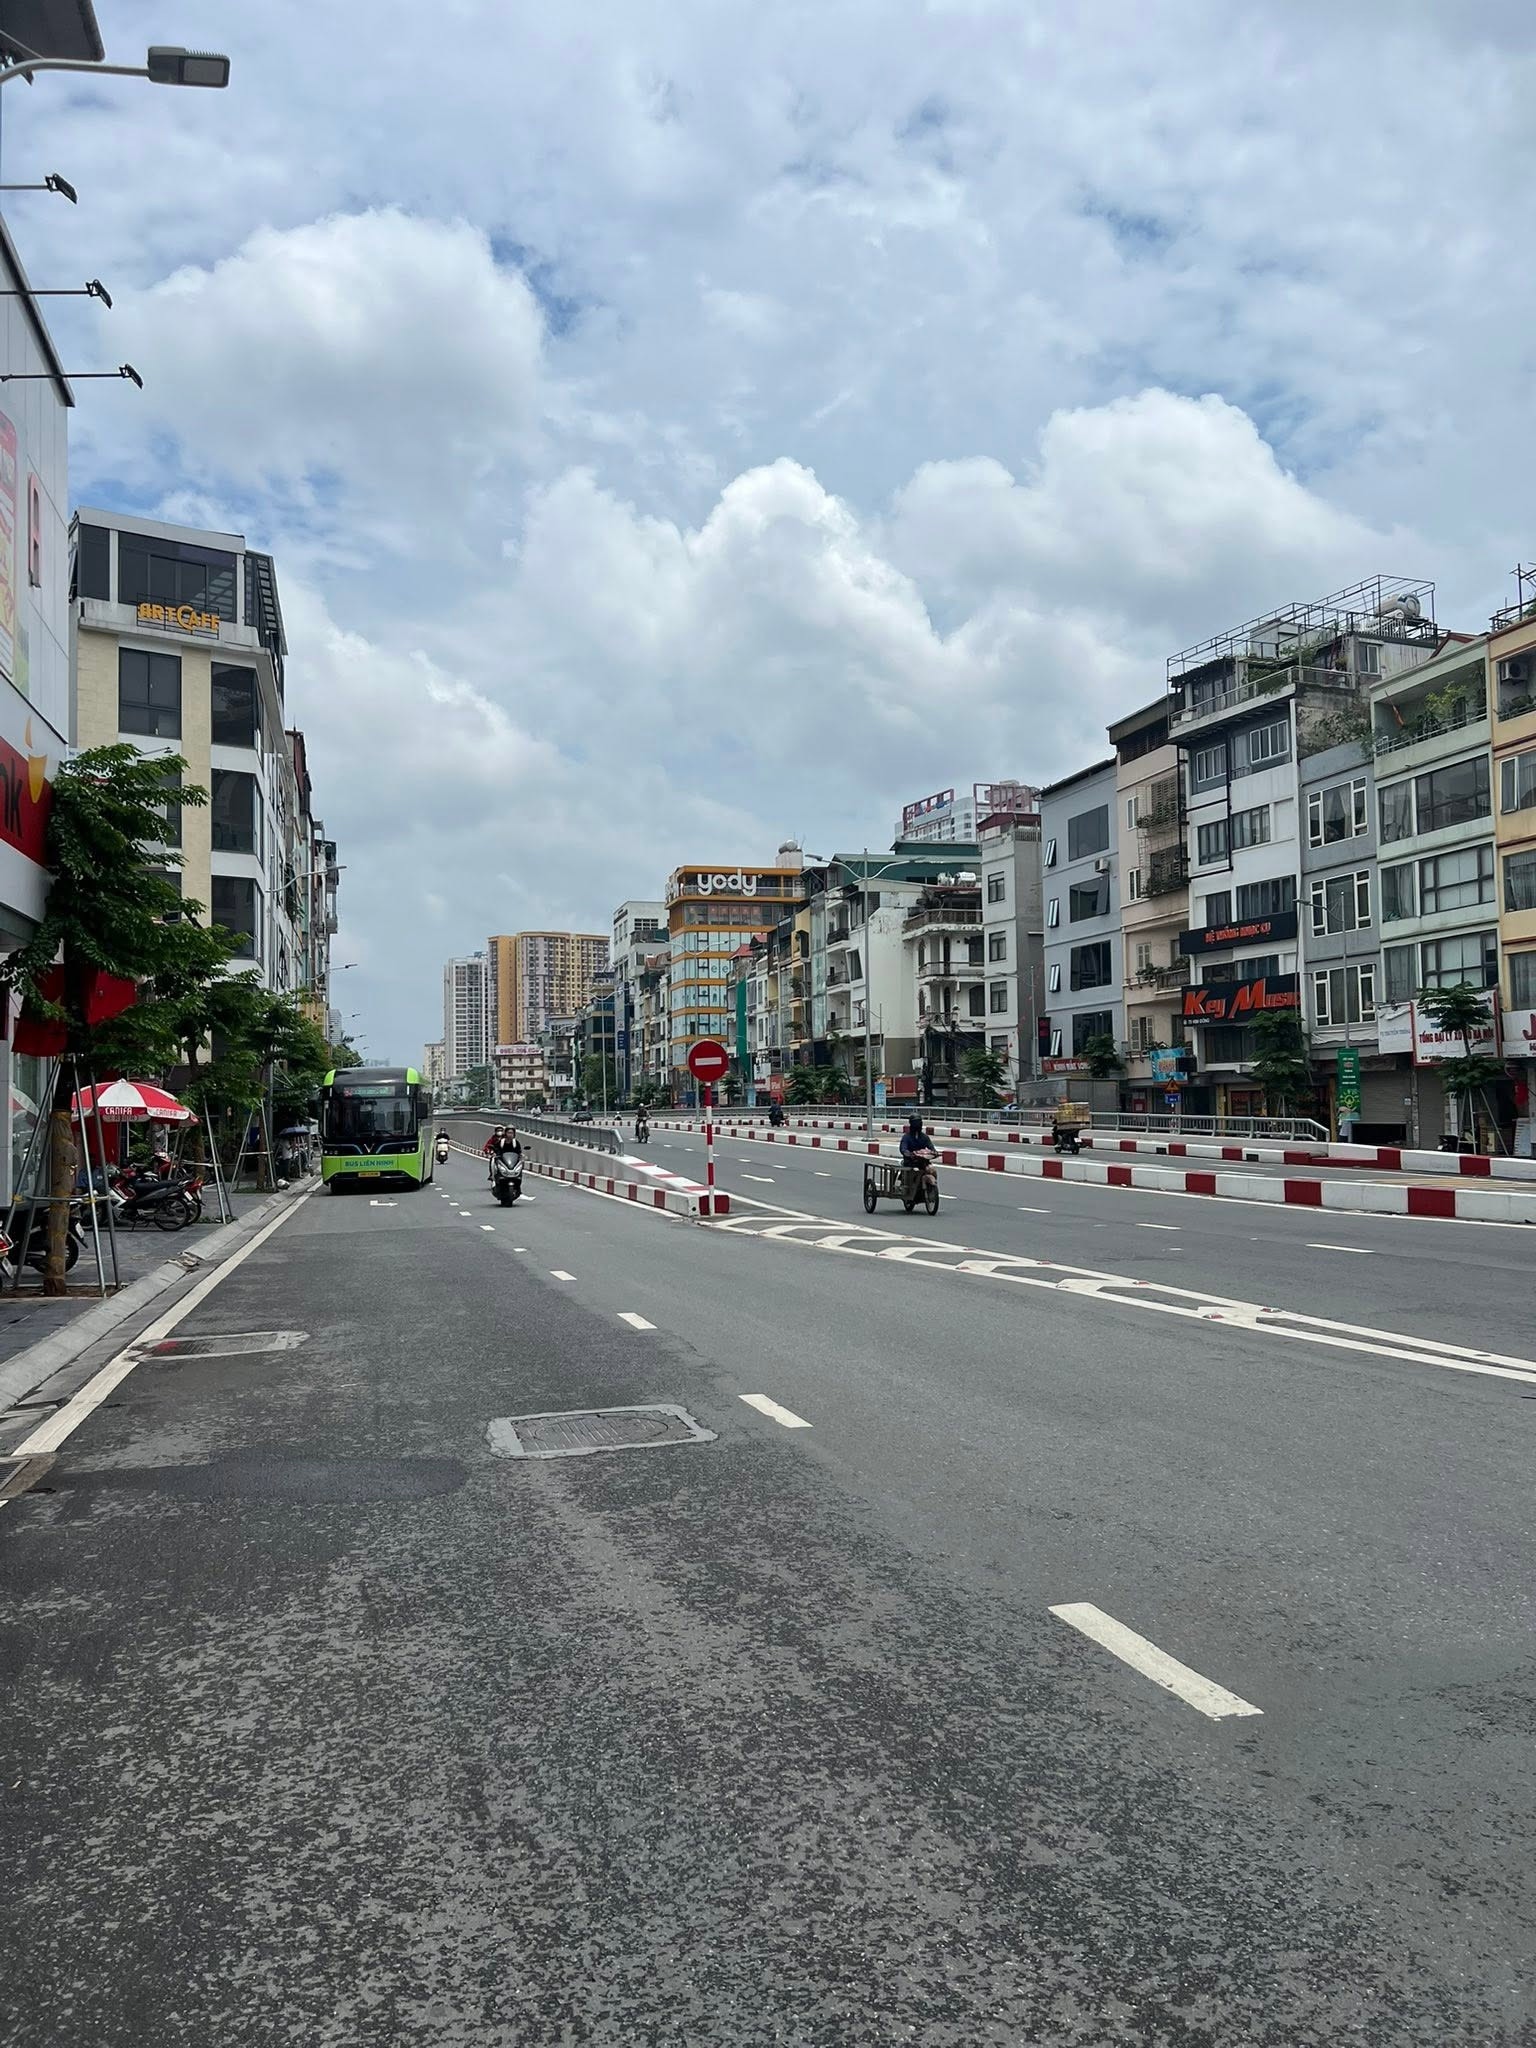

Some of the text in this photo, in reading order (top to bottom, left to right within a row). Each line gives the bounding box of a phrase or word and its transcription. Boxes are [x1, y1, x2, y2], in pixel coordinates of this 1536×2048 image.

[697, 868, 757, 897] yody
[1184, 989, 1226, 1019] Key
[105, 1107, 133, 1115] CANIFA
